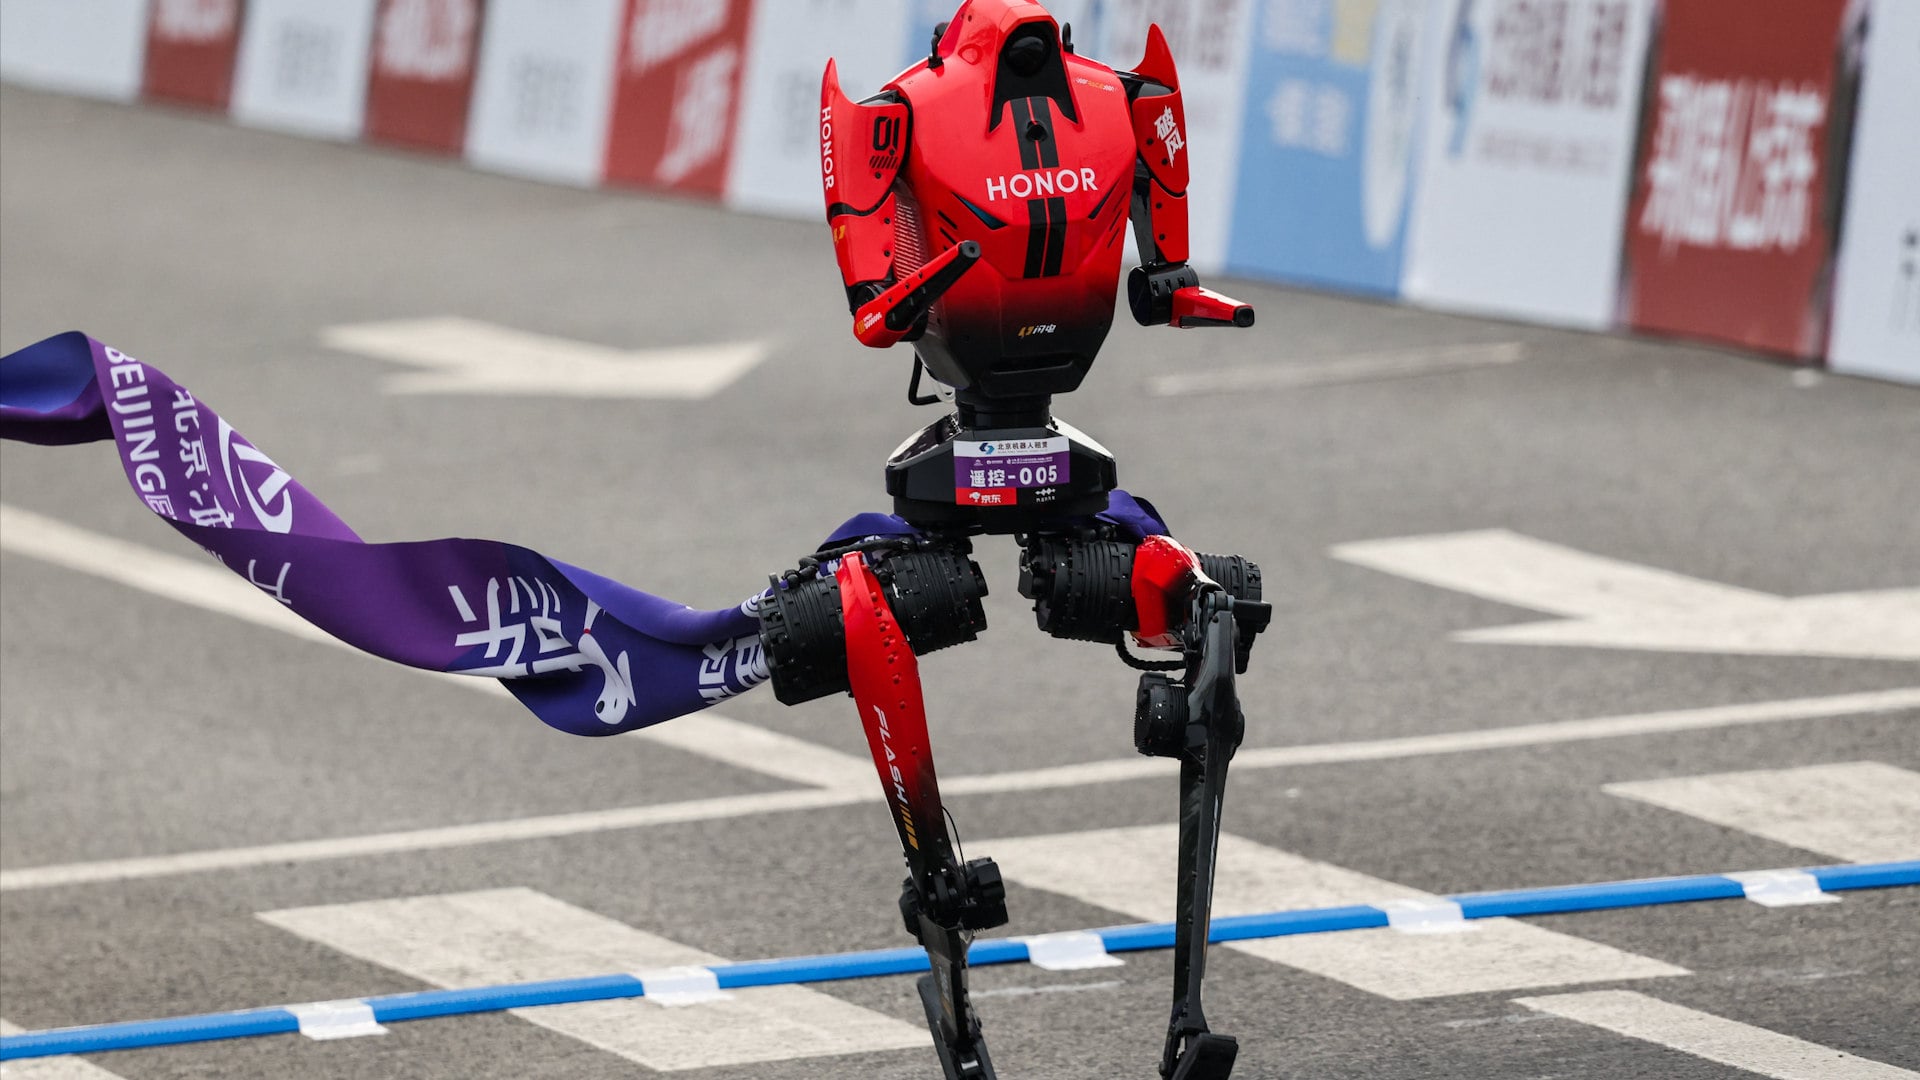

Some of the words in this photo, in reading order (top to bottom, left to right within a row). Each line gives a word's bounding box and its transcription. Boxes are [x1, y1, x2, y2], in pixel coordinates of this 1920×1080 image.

[822, 106, 834, 190] HONOR
[1154, 105, 1185, 168] 破风
[986, 168, 1098, 201] HONOR
[997, 441, 1048, 451] 北京机器人租赁
[970, 465, 1058, 487] 遥控-005
[981, 494, 1001, 503] 京东
[873, 704, 908, 804] FLASH
